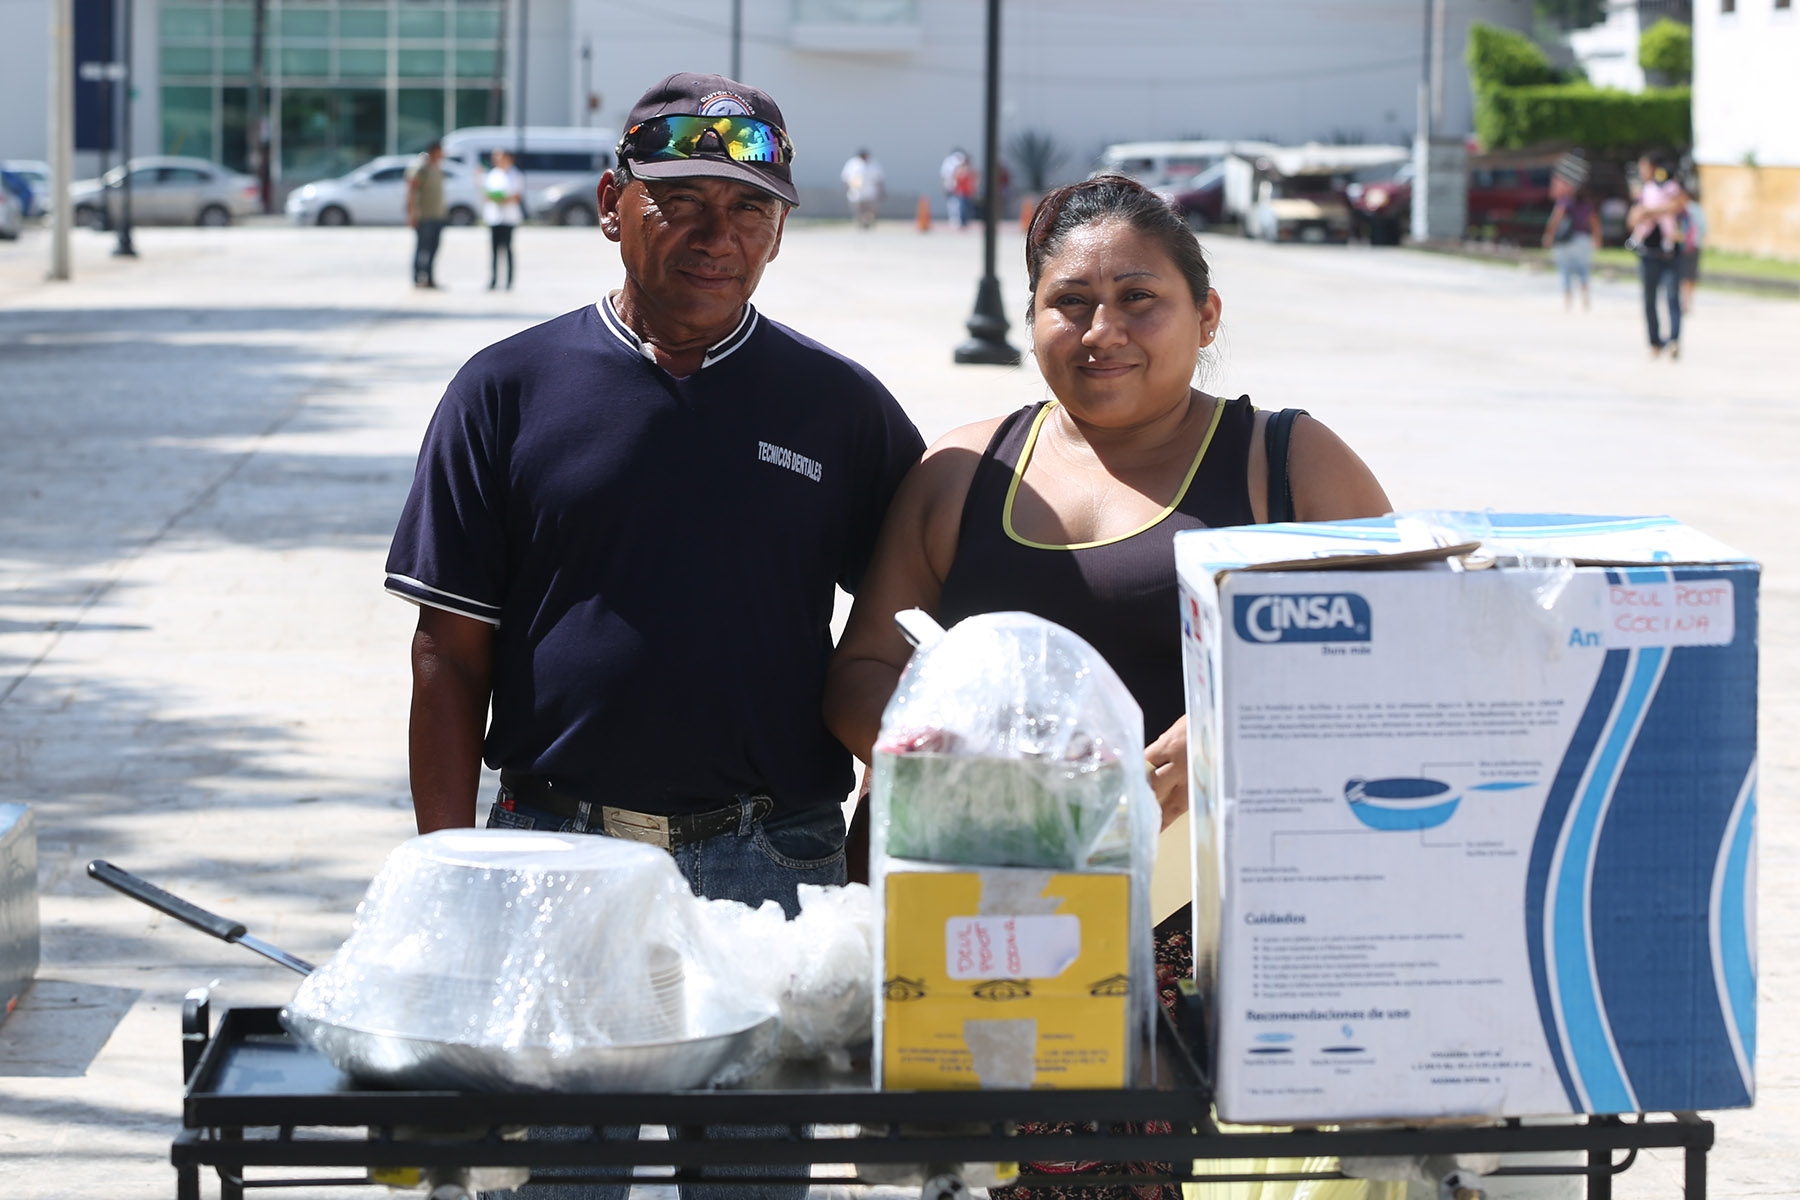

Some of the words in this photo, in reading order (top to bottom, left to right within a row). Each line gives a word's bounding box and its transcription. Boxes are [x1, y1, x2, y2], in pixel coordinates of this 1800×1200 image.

[758, 440, 792, 469] TECNICOS
[791, 452, 823, 482] DENTALES
[1614, 612, 1711, 634] COCINA
[1367, 1007, 1383, 1021] de
